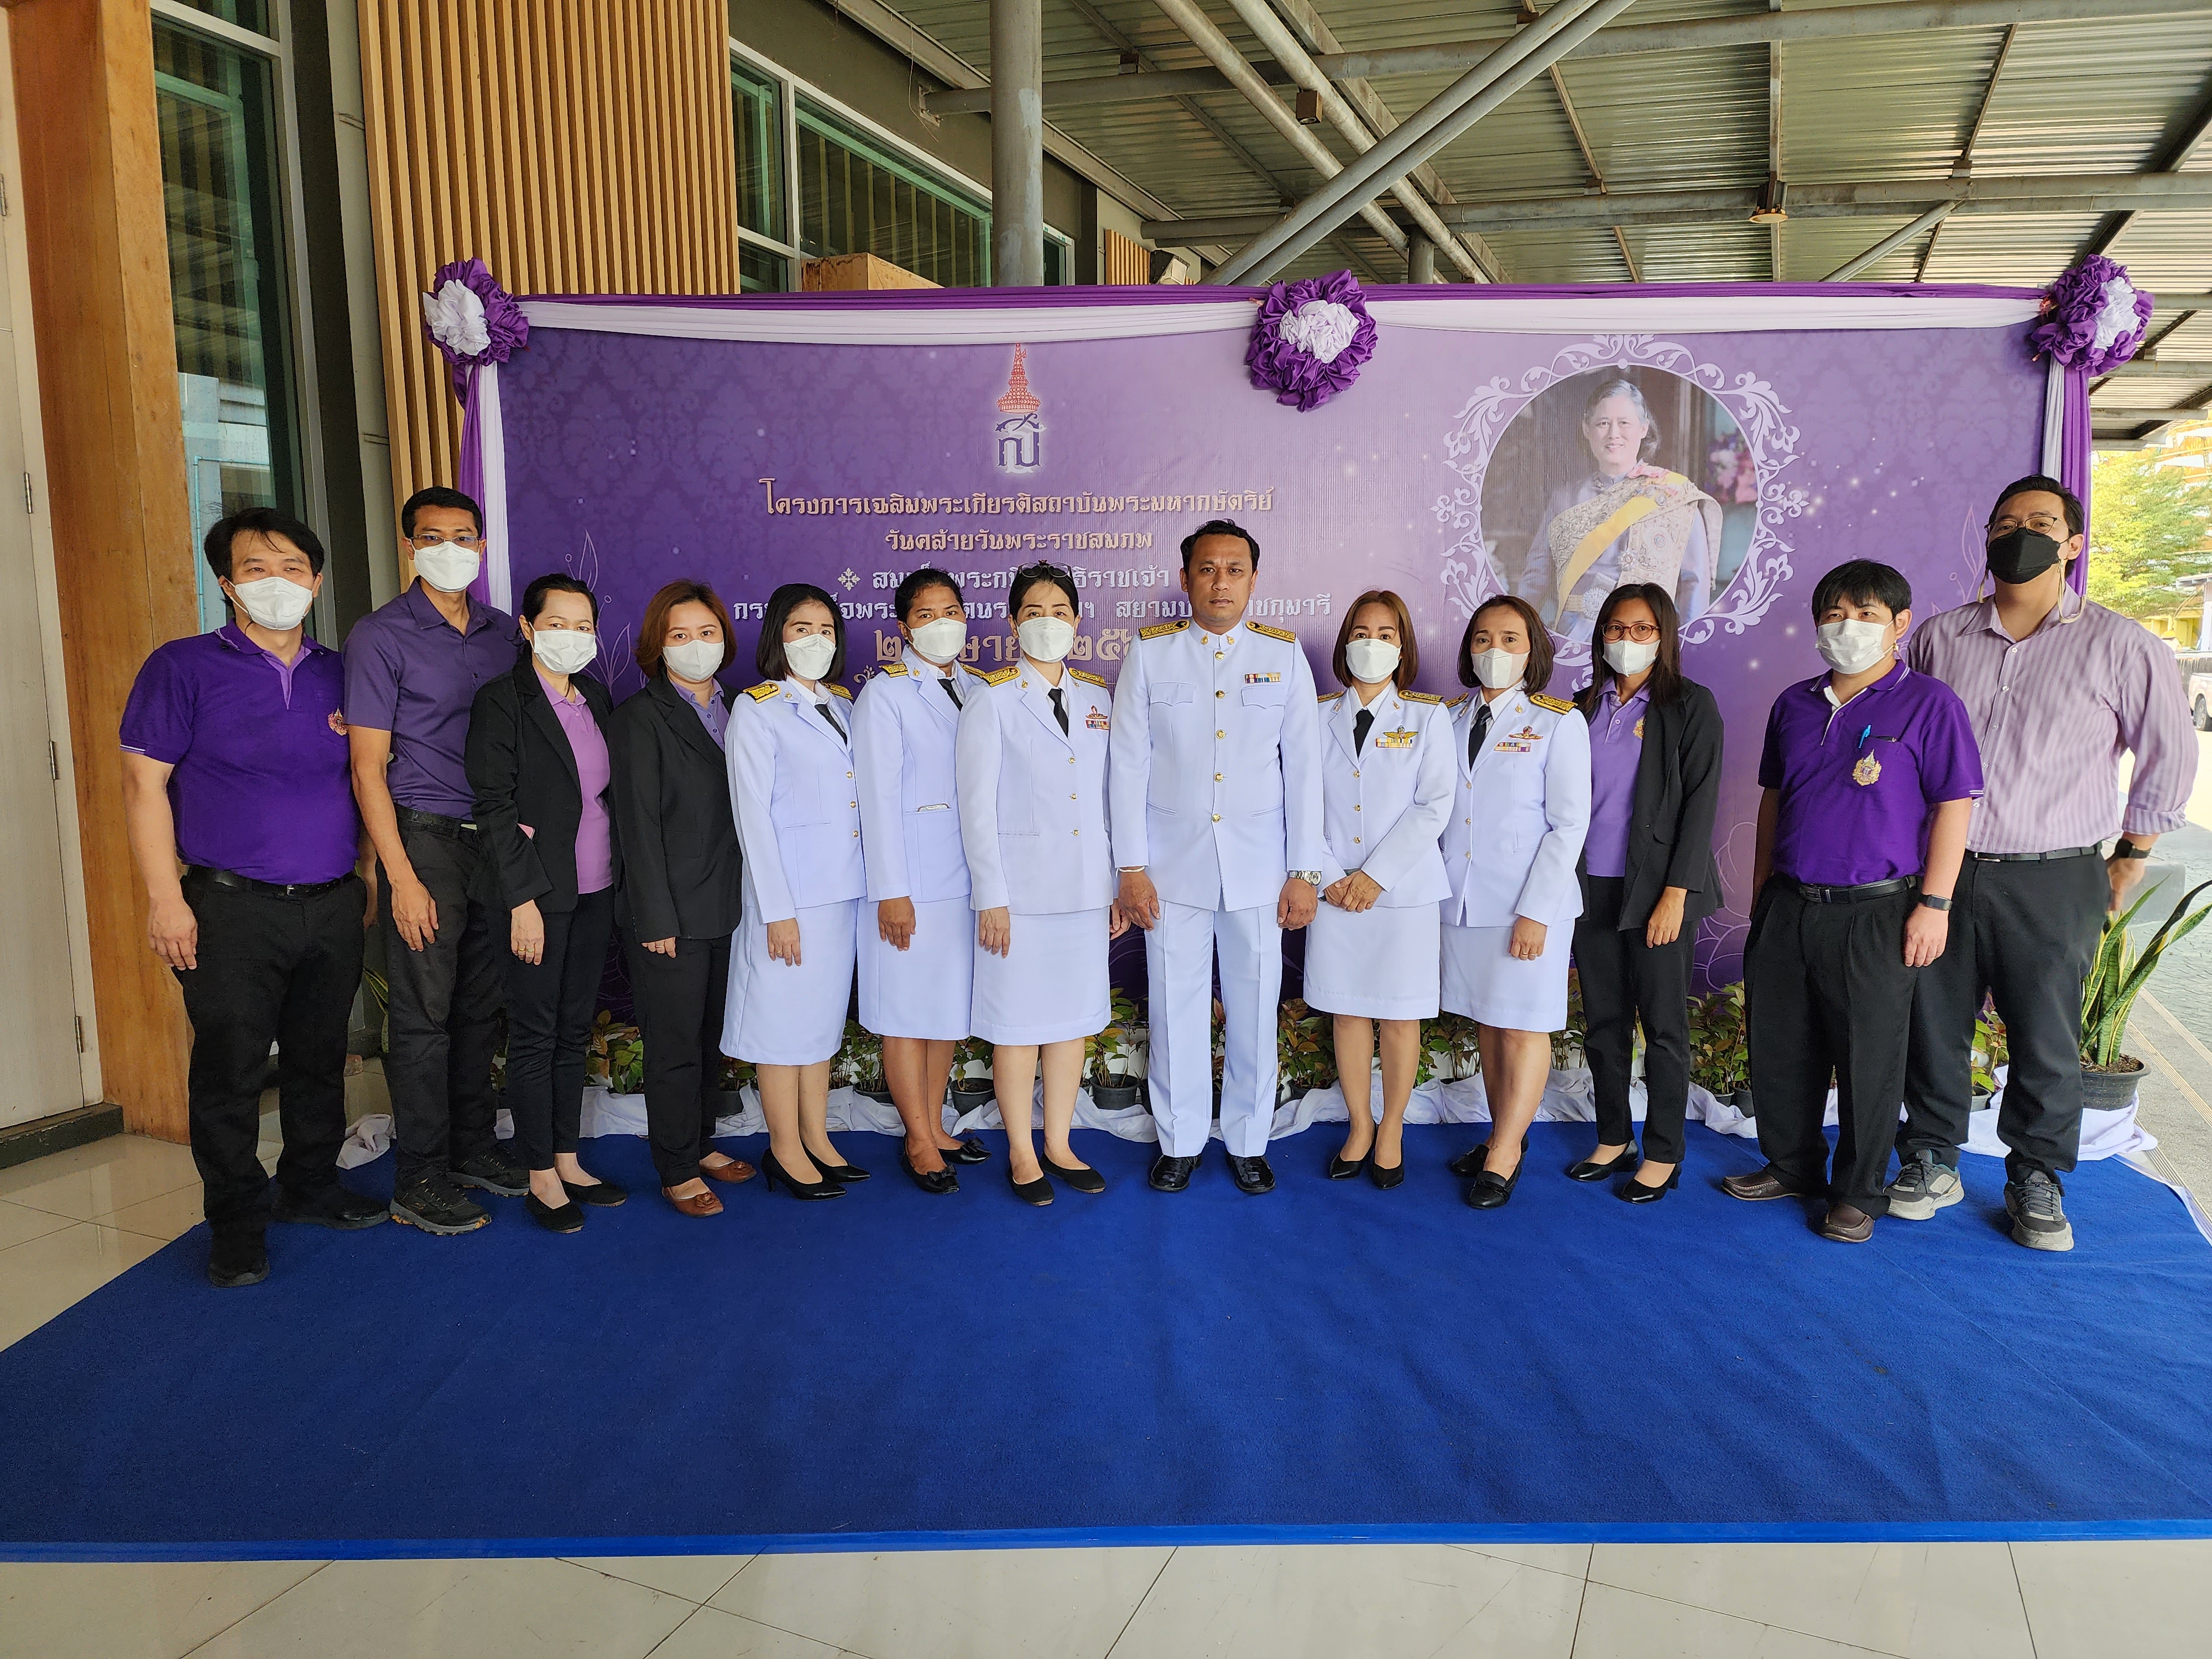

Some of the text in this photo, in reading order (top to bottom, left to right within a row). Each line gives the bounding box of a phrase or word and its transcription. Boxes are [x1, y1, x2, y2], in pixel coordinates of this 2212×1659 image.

[758, 478, 1275, 515] โครงการเฉลิมพระเกียรติสถาบันพระมหากษัตริย์
[884, 528, 1153, 551] วันคล้ายวันพระราชสมภพ
